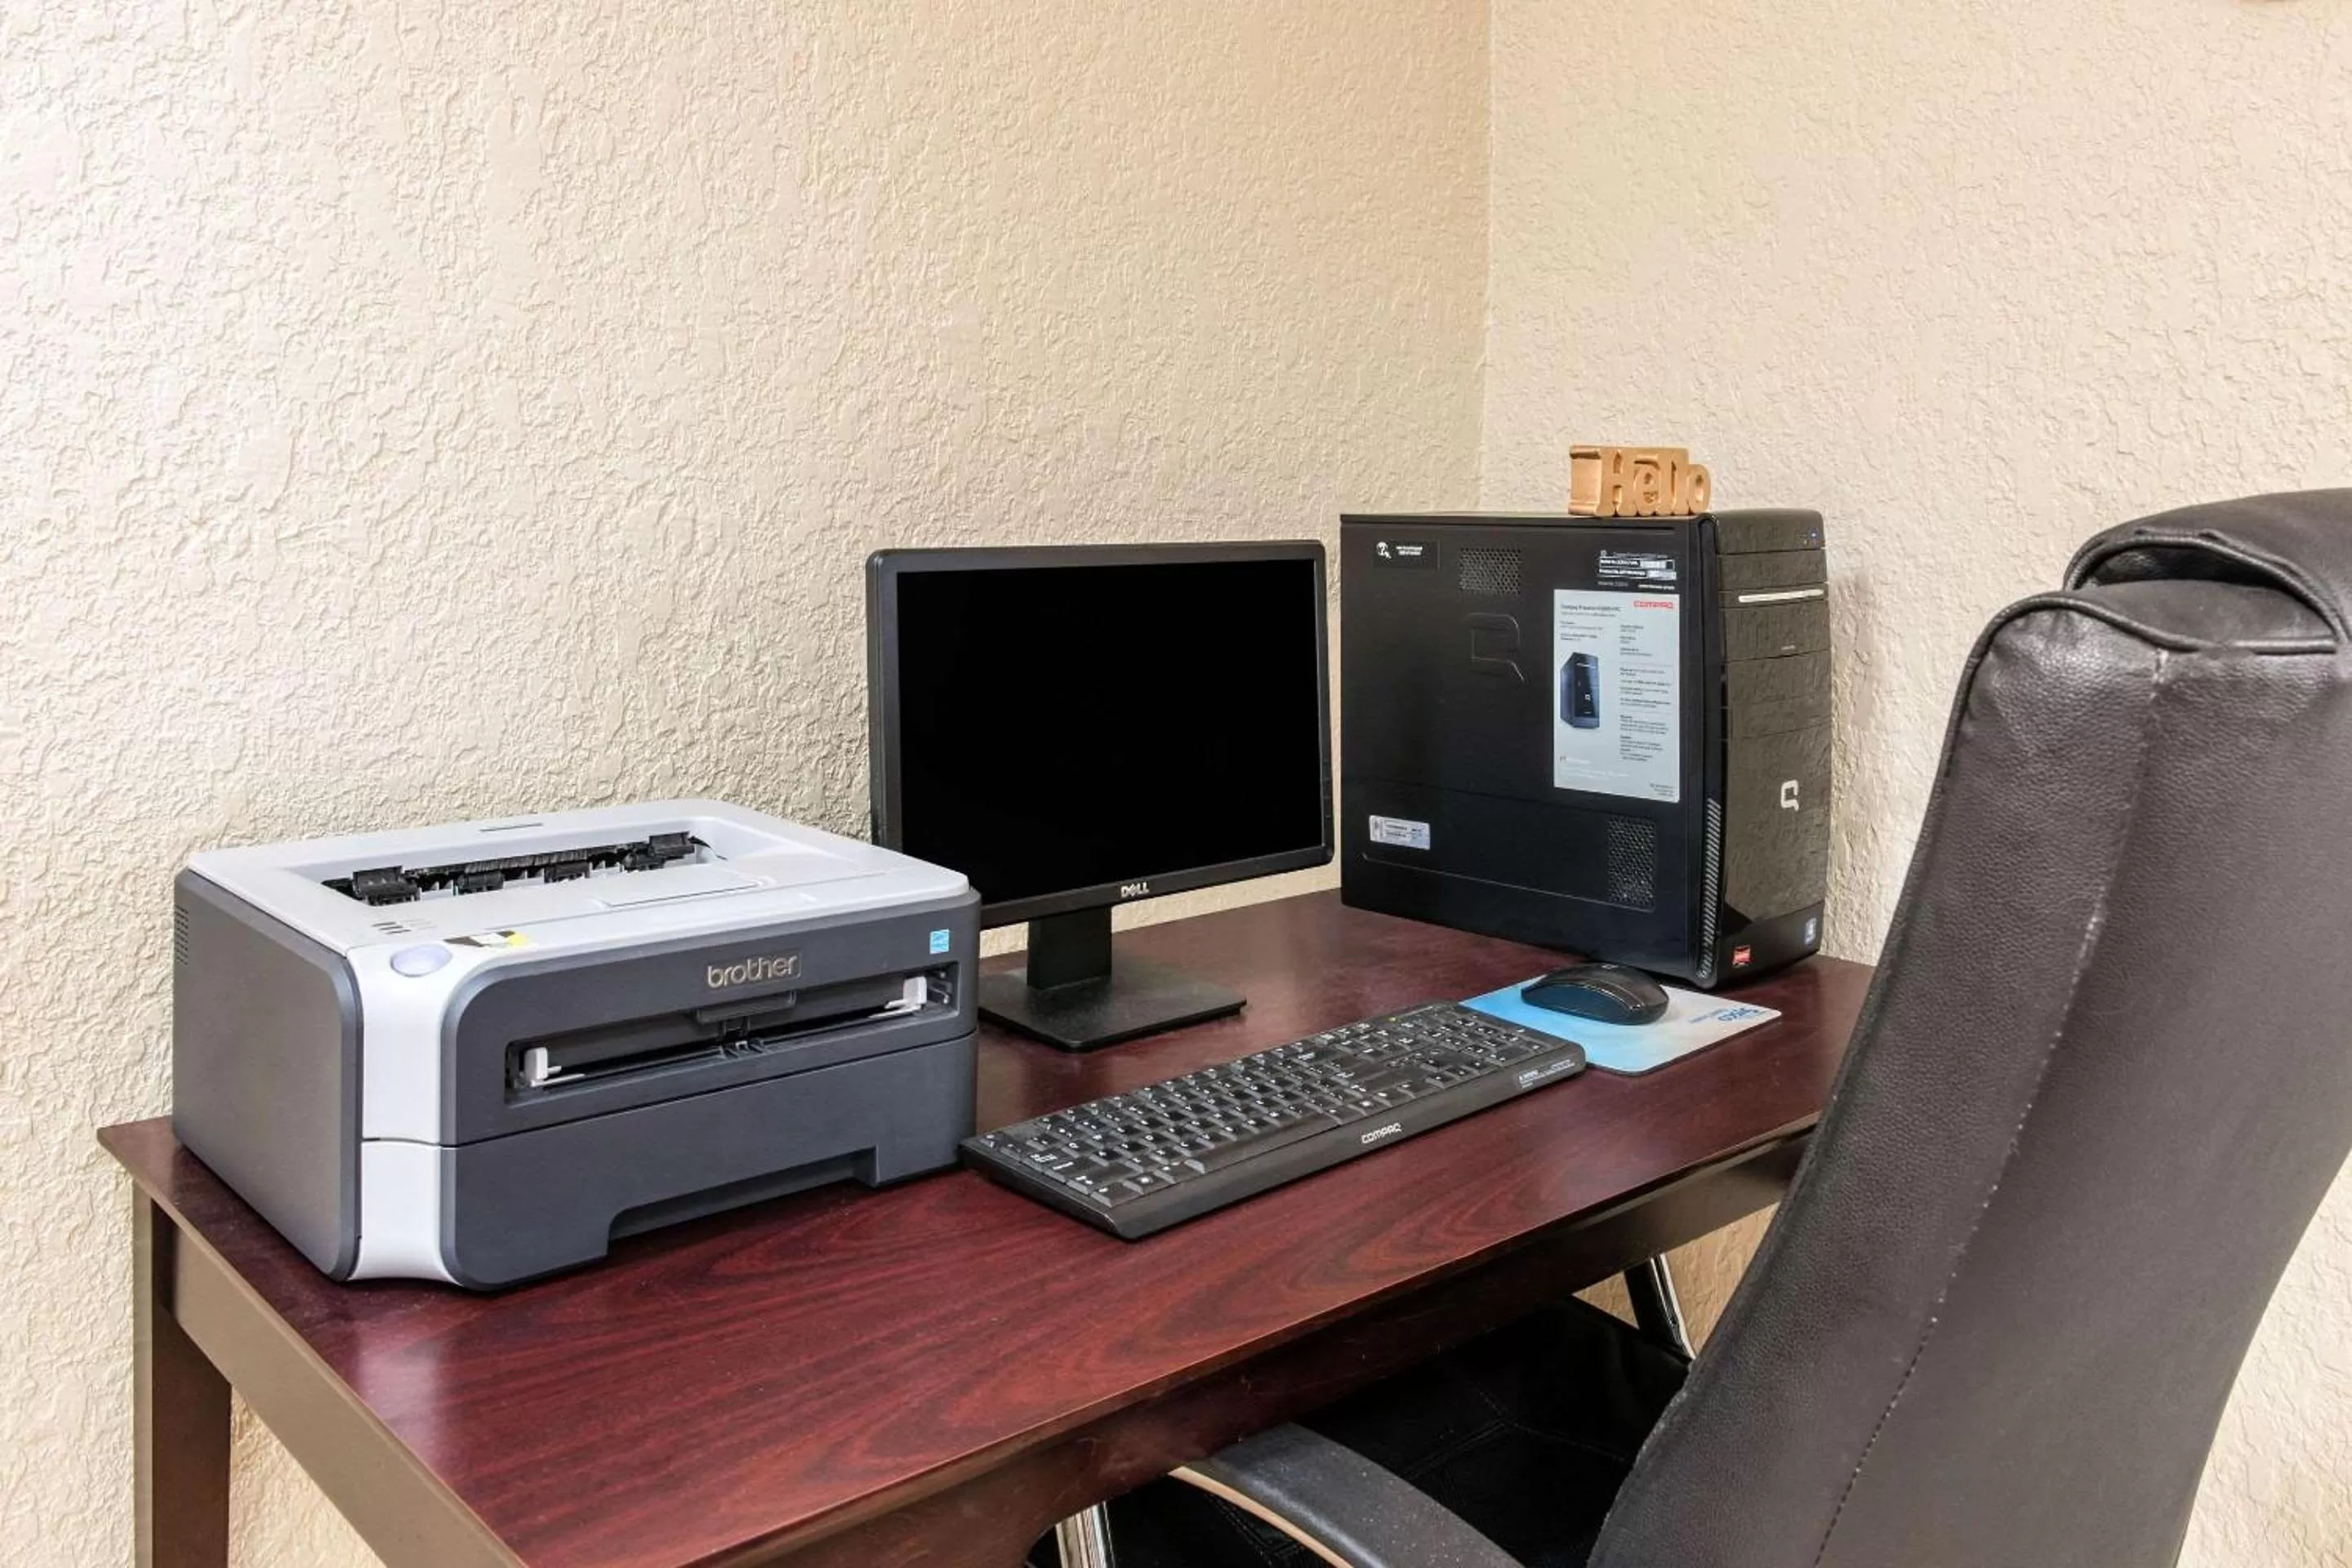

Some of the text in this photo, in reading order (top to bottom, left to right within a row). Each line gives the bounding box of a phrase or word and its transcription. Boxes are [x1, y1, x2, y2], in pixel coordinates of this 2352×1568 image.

[1596, 446, 1712, 517] Hello
[1120, 881, 1150, 898] DELL
[707, 955, 798, 989] brother
[1361, 1122, 1402, 1143] COMPAQ
